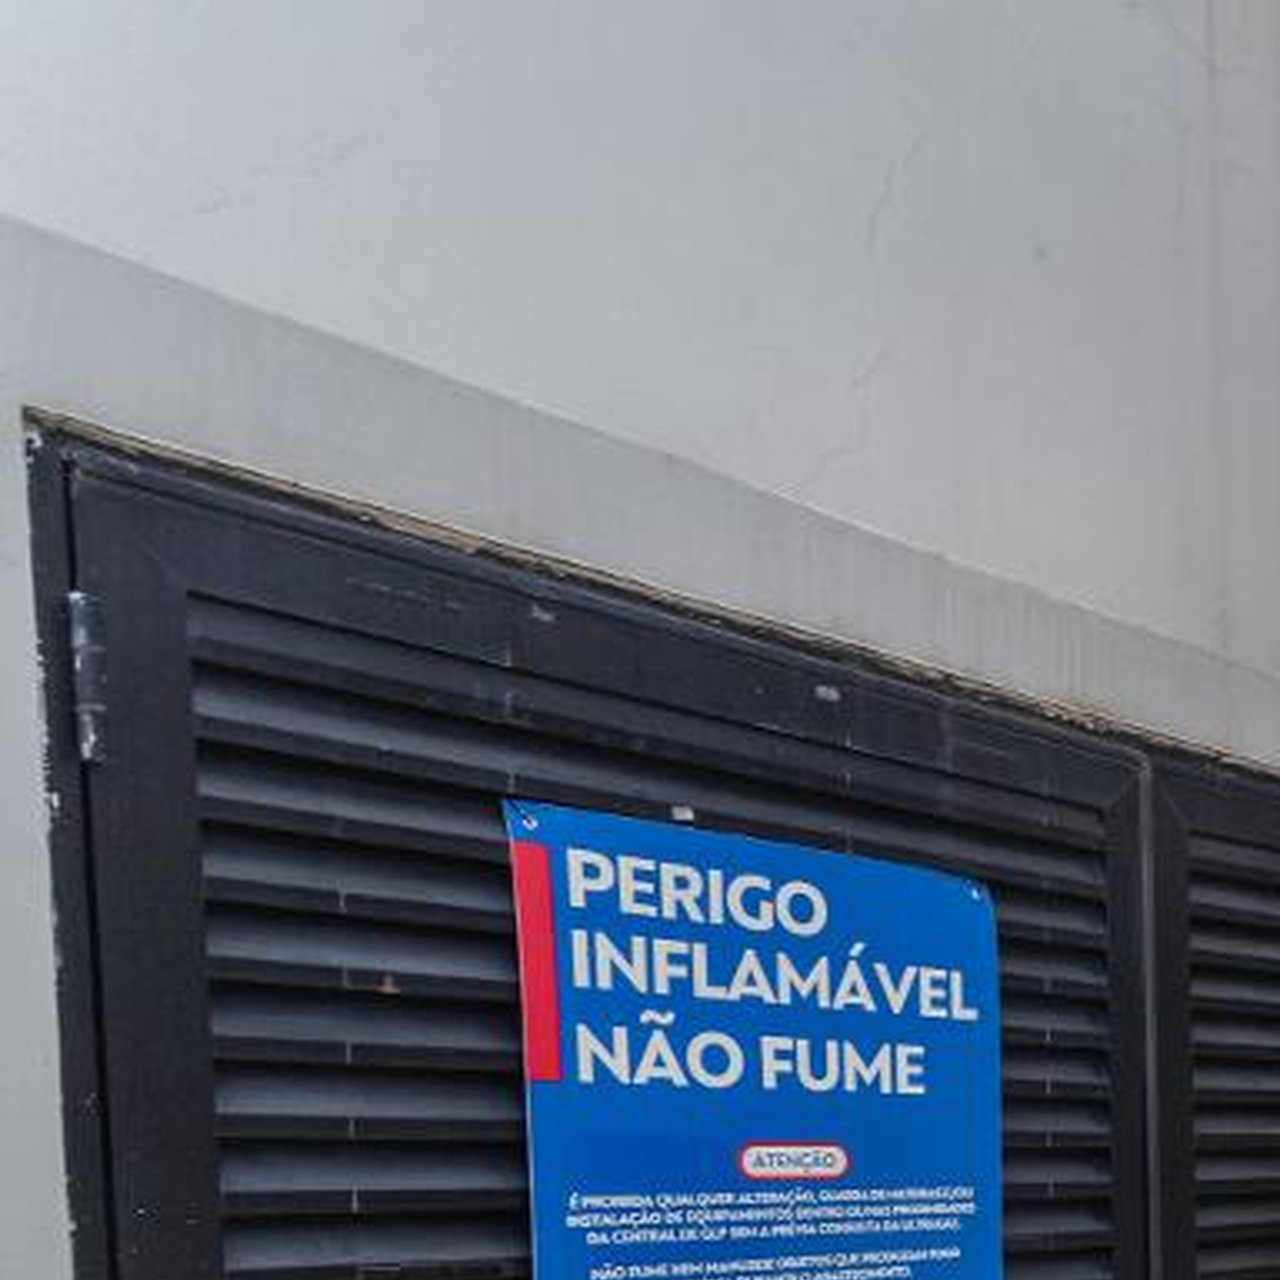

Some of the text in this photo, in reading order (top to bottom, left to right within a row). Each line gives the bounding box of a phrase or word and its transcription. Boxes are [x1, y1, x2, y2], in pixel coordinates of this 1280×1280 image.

[566, 848, 829, 937] PERIGO
[571, 928, 979, 1021] INFLAMÁVEL
[575, 1008, 926, 1095] NÃO FUME
[656, 1192, 732, 1209] QUALQUER
[664, 1210, 683, 1224] DE
[586, 1231, 609, 1245] DA
[612, 1229, 677, 1244] CENTRAL
[590, 1262, 625, 1280] NÃO
